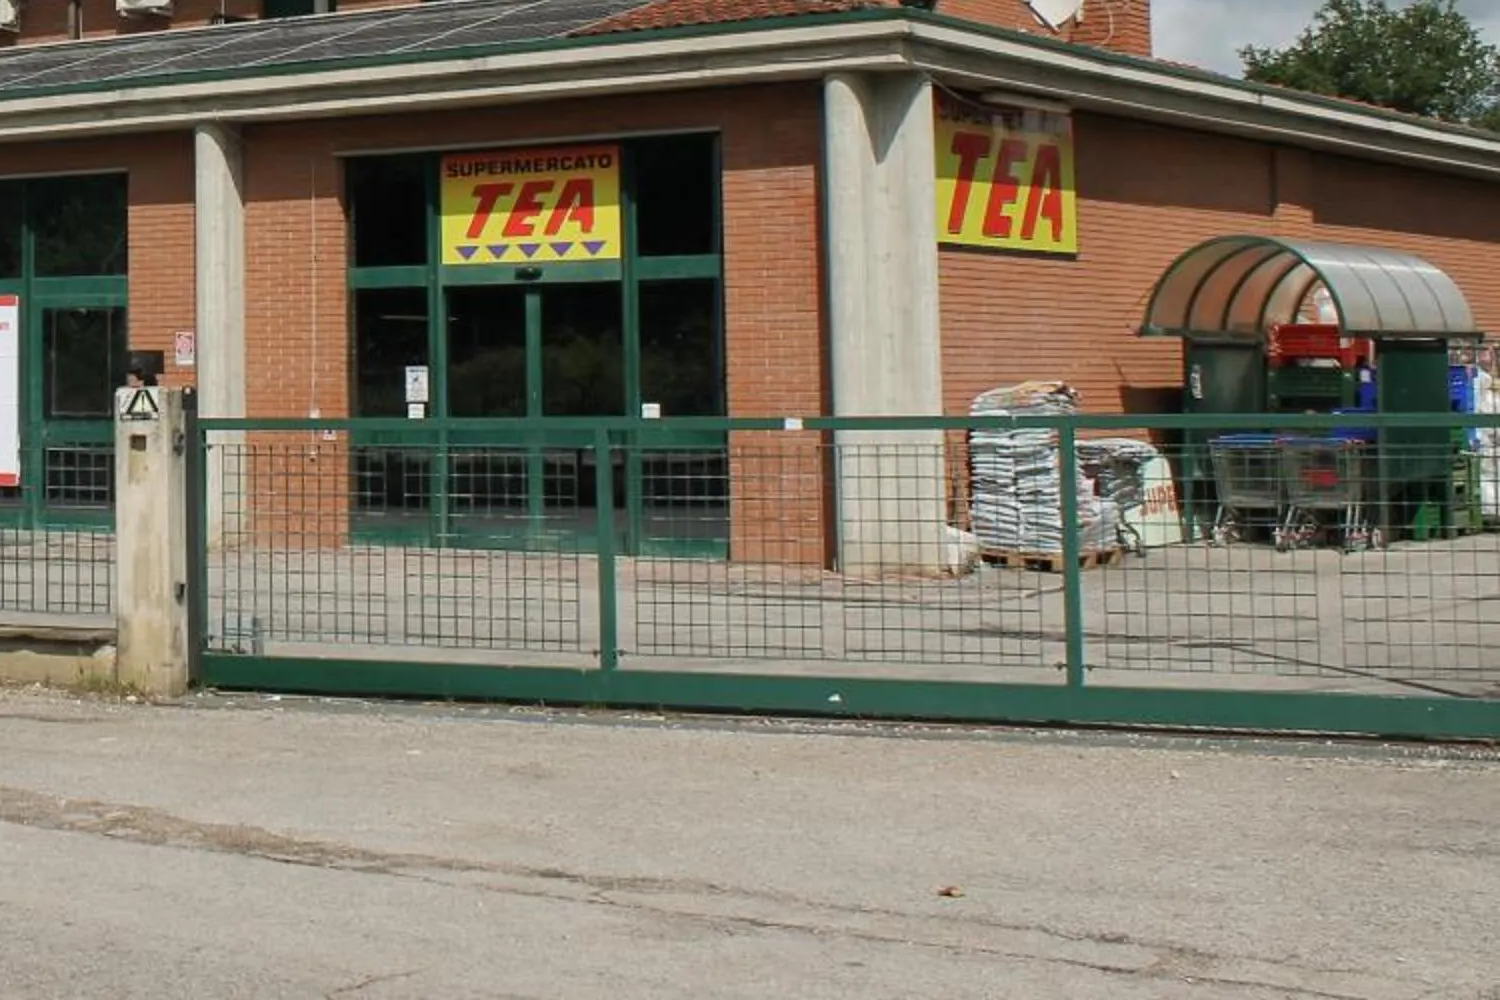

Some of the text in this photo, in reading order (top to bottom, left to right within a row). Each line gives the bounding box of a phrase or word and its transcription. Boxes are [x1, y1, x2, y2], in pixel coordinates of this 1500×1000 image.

[447, 154, 613, 178] SUPERMERCATO
[947, 130, 1062, 243] TEA
[465, 178, 595, 240] TEA
